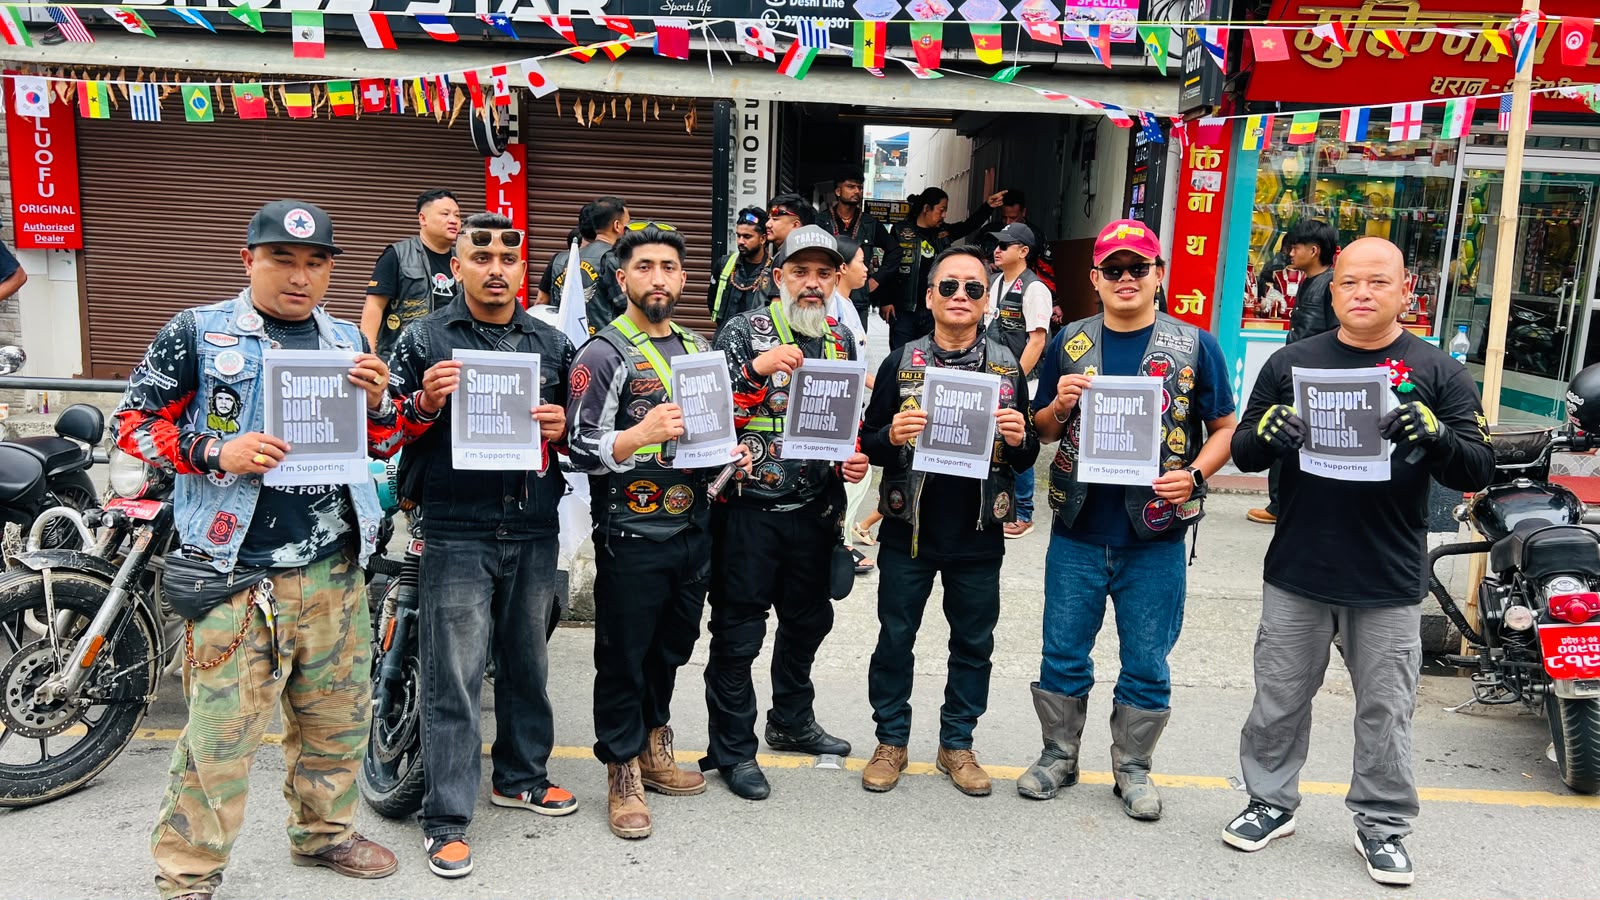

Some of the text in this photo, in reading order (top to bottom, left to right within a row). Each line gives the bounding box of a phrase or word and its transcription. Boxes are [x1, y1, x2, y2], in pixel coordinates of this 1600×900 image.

[743, 98, 759, 195] SHOES
[34, 116, 55, 198] LUOFU
[19, 203, 76, 215] ORIGINAL
[23, 222, 75, 232] Authorized
[34, 233, 65, 243] Dealer
[281, 371, 348, 407] Support.
[466, 368, 524, 402] Support.
[680, 371, 722, 403] Support.
[803, 375, 851, 404] Support.
[935, 384, 984, 416] Support.
[1094, 392, 1148, 421] Support.
[1308, 386, 1372, 416] Support.
[804, 444, 838, 453] Supporting
[480, 452, 520, 460] Supporting
[936, 456, 972, 468] Supporting
[280, 464, 344, 472] I'm Supporting
[1102, 466, 1140, 476] Supporting
[1310, 458, 1368, 472] I'm Supporting
[299, 485, 326, 495] FOR
